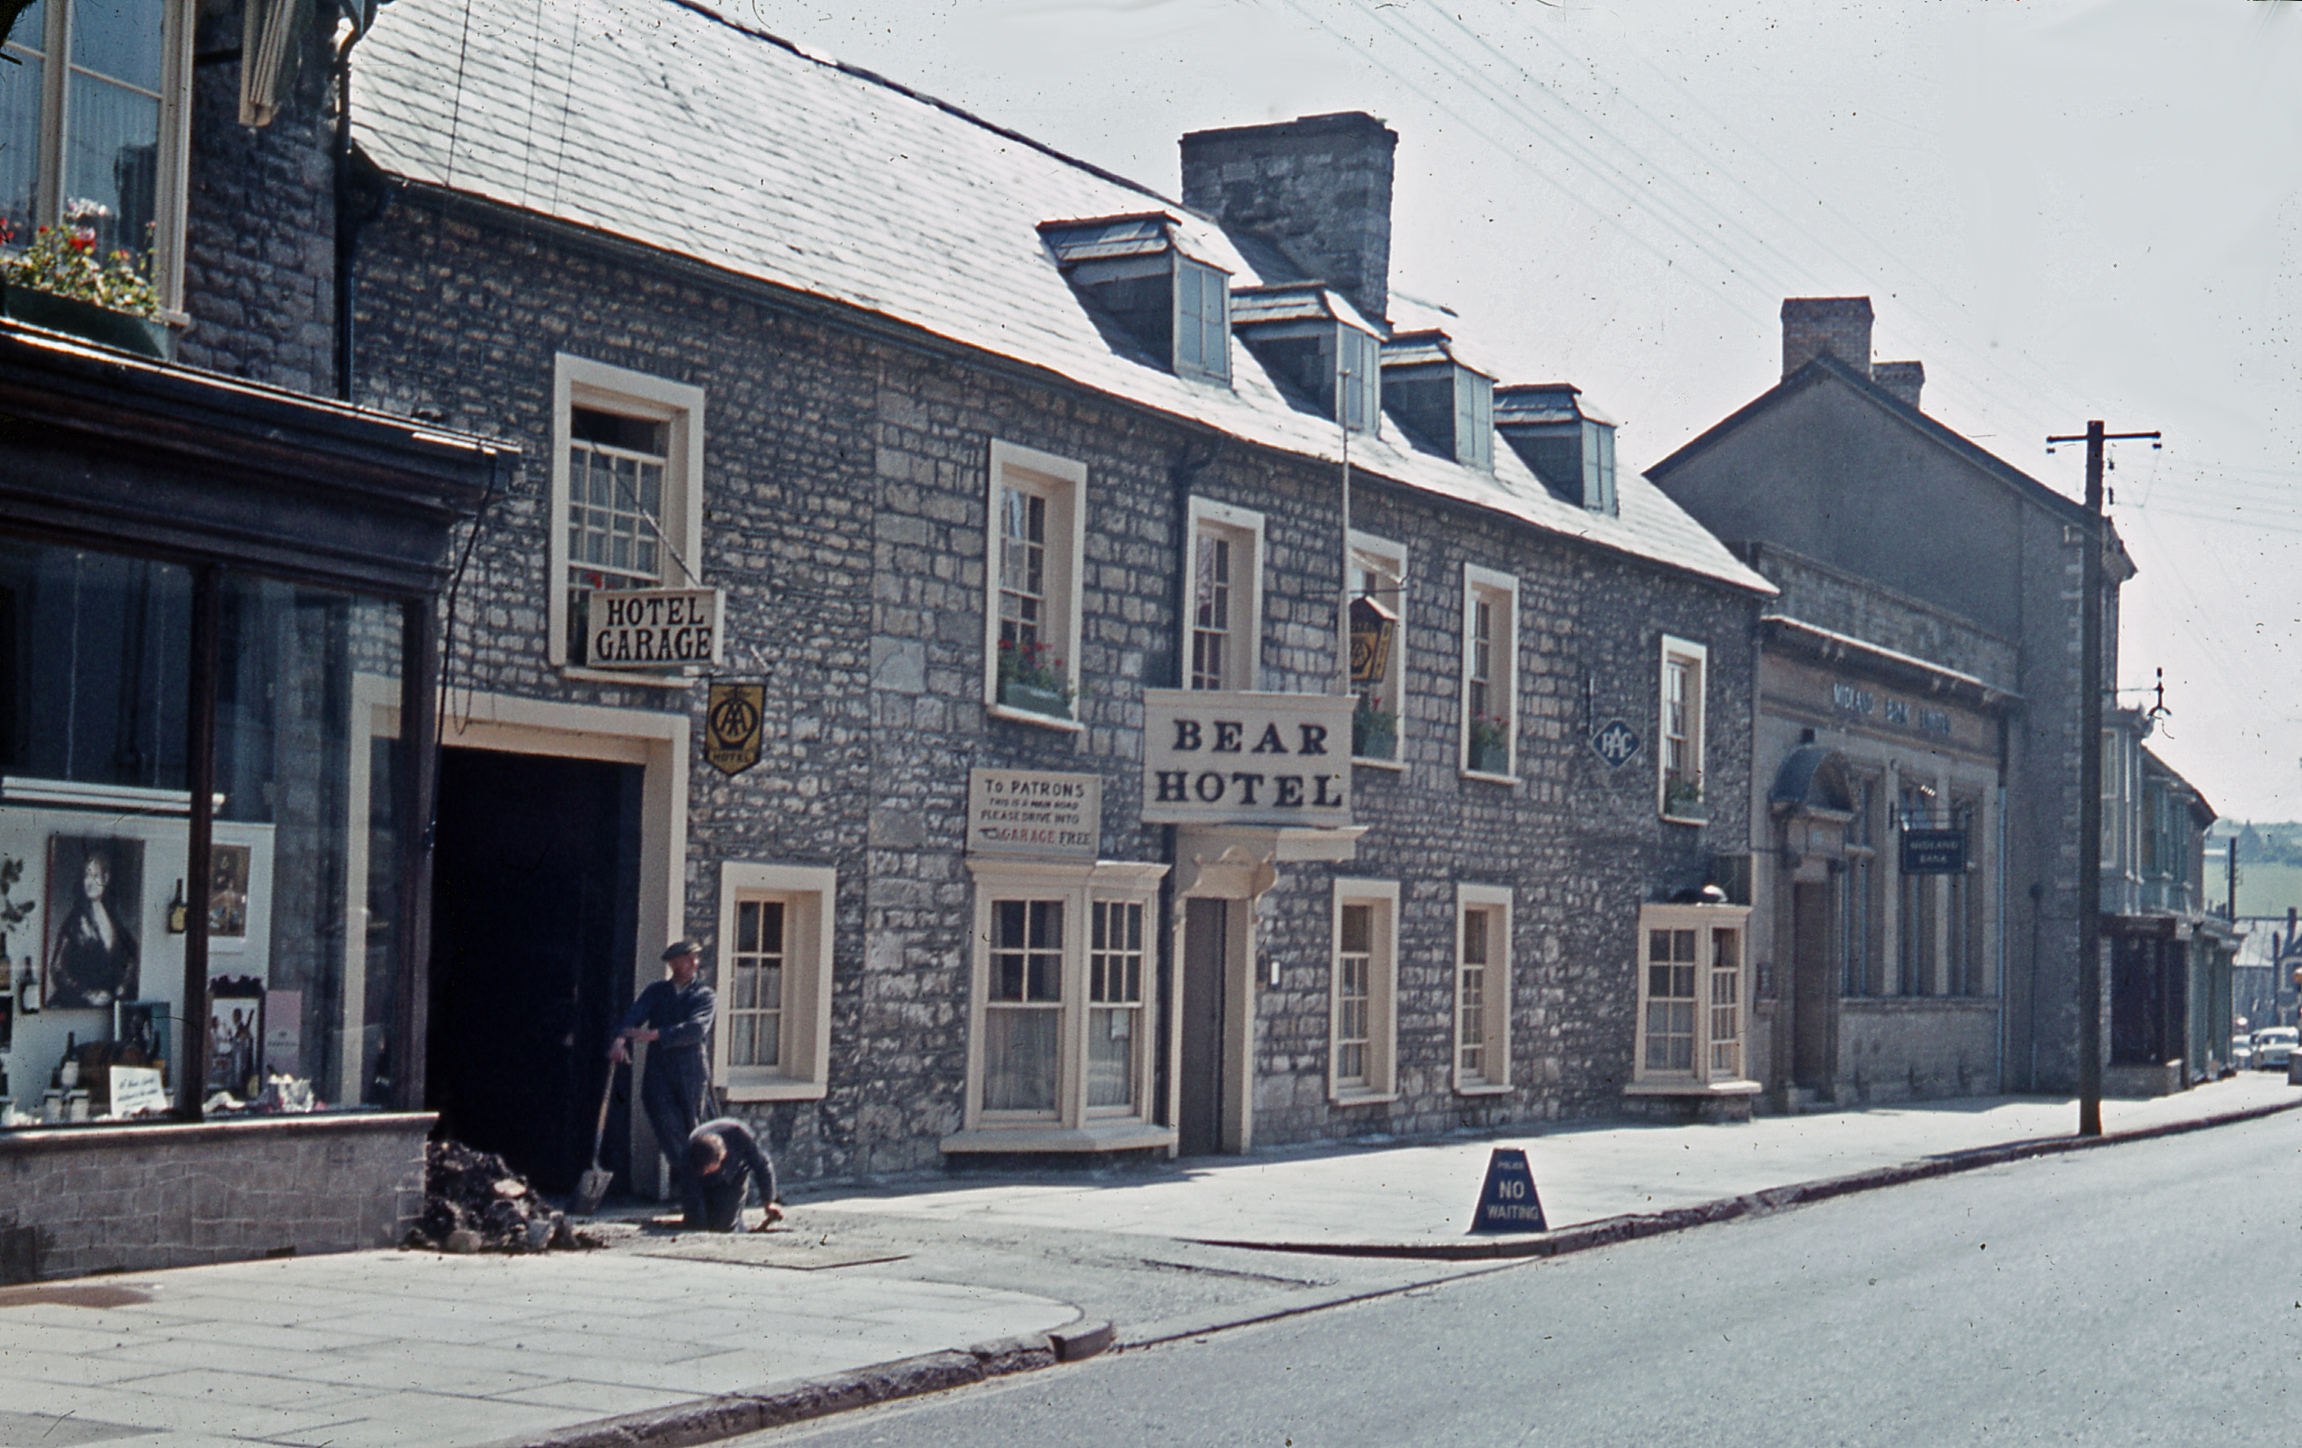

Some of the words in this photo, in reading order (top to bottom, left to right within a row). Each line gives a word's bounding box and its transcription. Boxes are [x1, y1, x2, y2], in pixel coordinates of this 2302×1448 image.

[605, 596, 705, 627] HOTEL
[595, 627, 712, 661] GARAGE
[719, 703, 748, 736] AA
[1172, 719, 1329, 756] BEAR
[1602, 726, 1633, 758] RAC
[984, 778, 1004, 794] TO
[1011, 780, 1085, 798] PATRONS
[1155, 770, 1343, 807] HOTEL
[980, 809, 1020, 822] PLEASE
[1021, 812, 1051, 824] DRIVE
[1054, 814, 1080, 825] INTO
[1002, 828, 1056, 845] GARAGE
[1058, 831, 1092, 846] FREE
[1499, 1180, 1525, 1199] NO
[1486, 1205, 1540, 1220] WAITING
